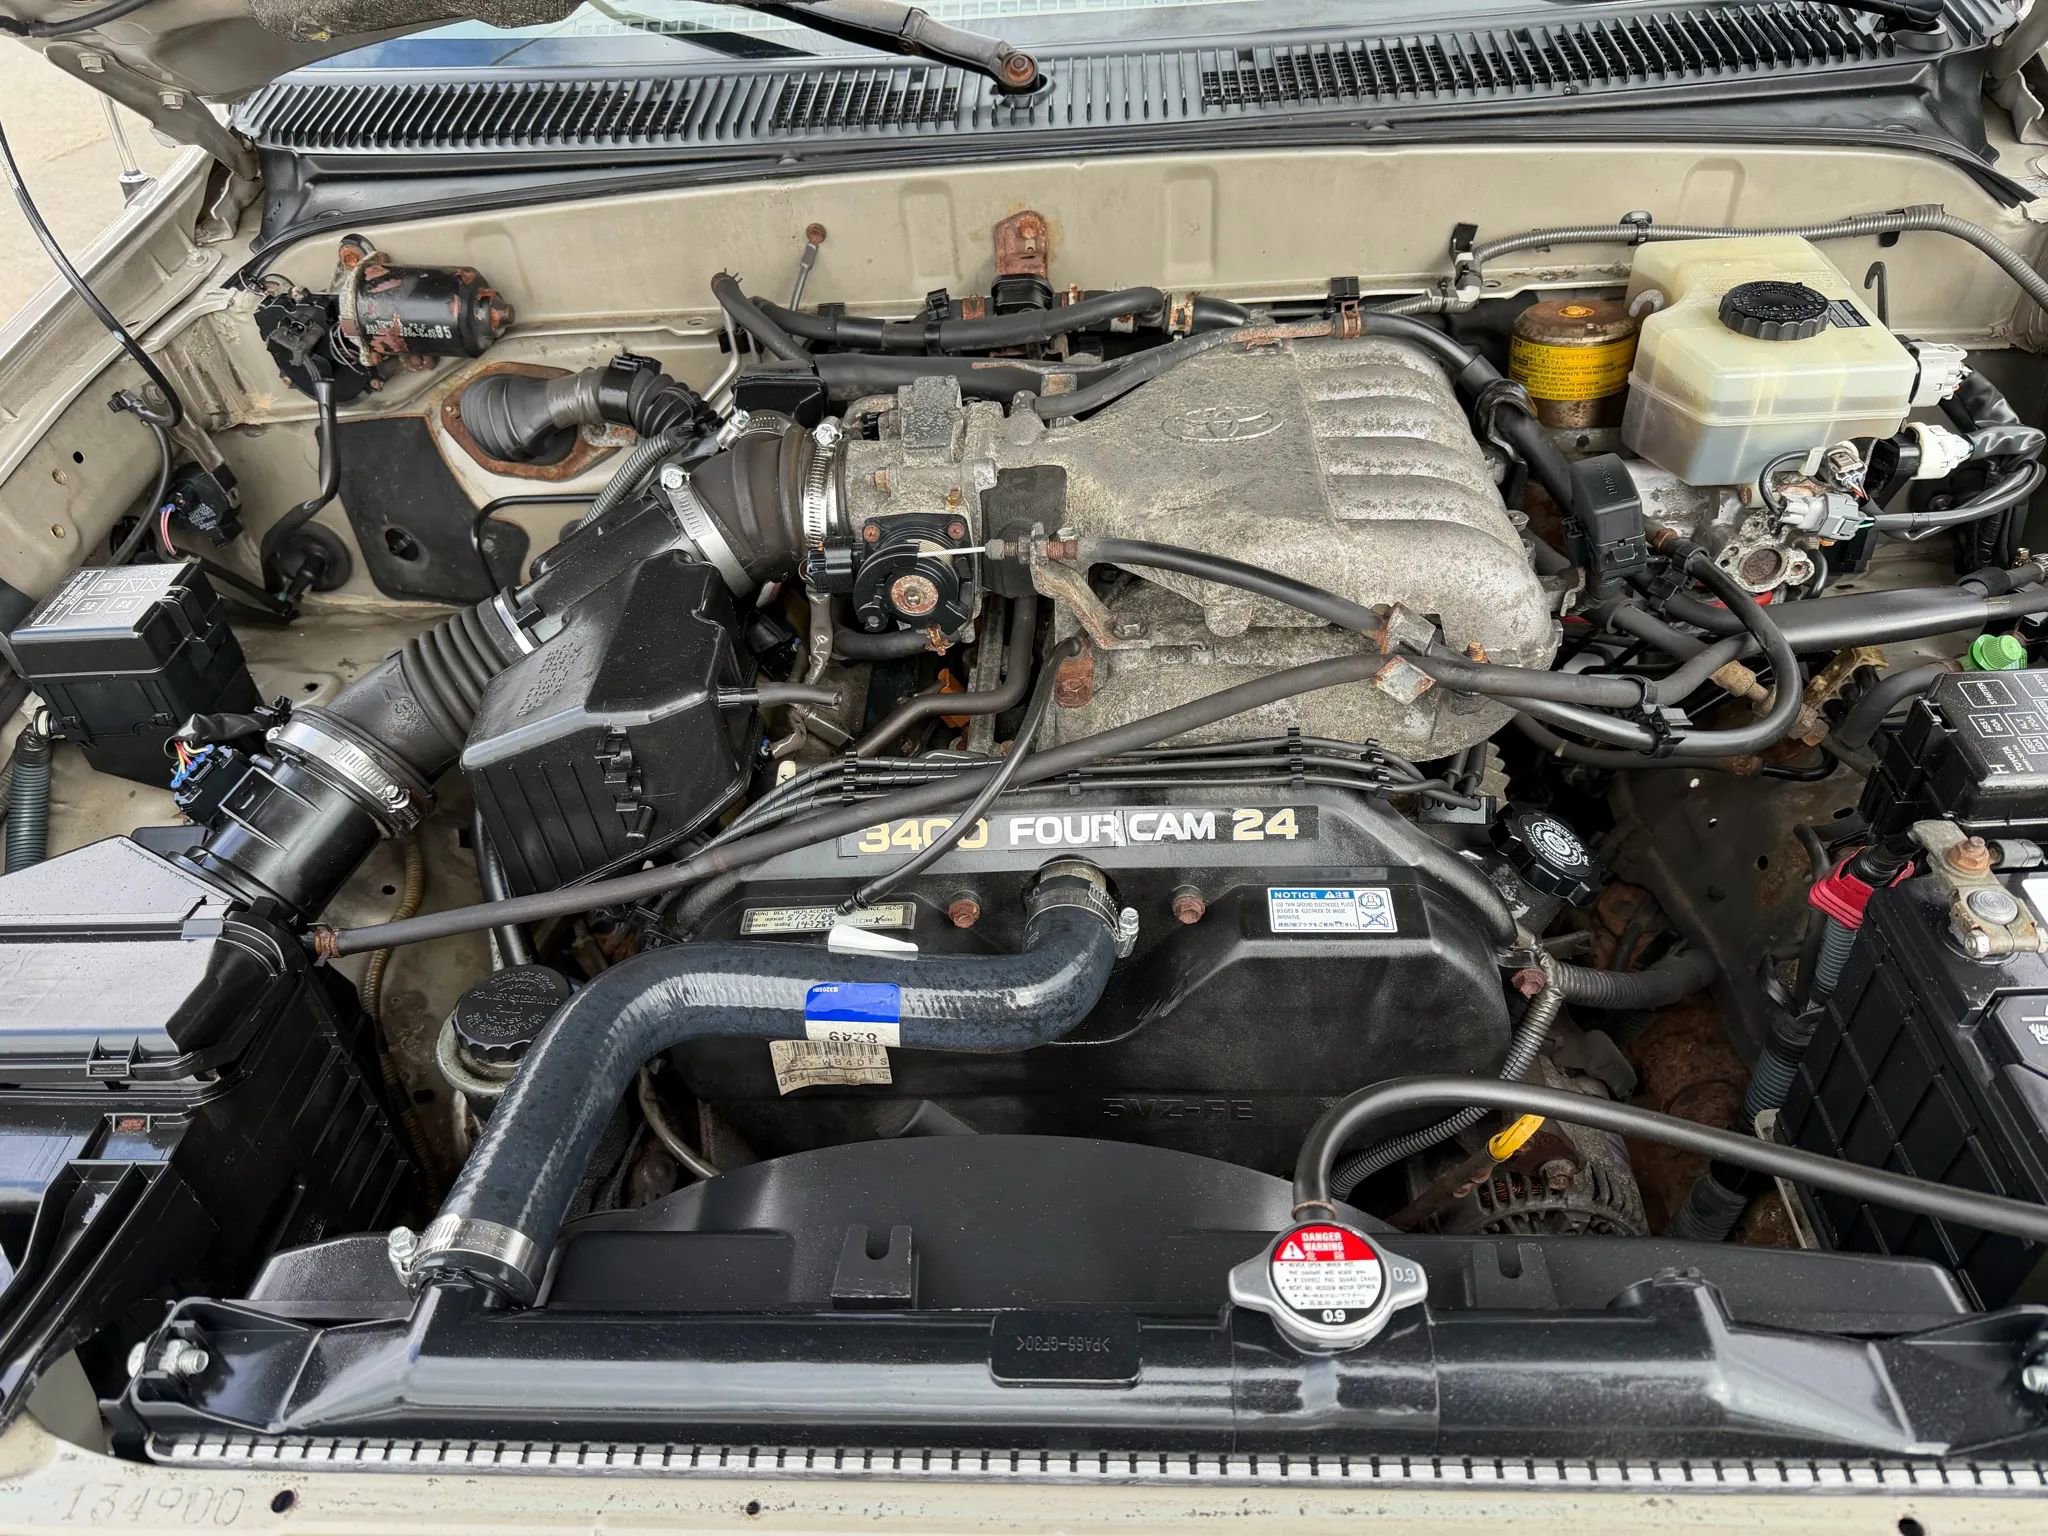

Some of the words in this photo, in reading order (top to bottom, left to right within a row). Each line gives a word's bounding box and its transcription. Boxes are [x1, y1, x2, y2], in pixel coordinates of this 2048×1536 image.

[1977, 683, 1998, 704] STARTER
[2002, 746, 2024, 772] TOYOTA
[858, 817, 988, 853] 3400
[1009, 814, 1126, 847] FOUR
[1129, 812, 1216, 841] CAM
[1233, 808, 1299, 841] 24
[1274, 891, 1318, 899] NOTICE
[1301, 1231, 1342, 1241] DANGER
[1303, 1242, 1344, 1251] WARNING
[1392, 1266, 1417, 1284] 0.9
[1321, 1309, 1346, 1323] 0.9
[61, 1483, 246, 1526] 134900
